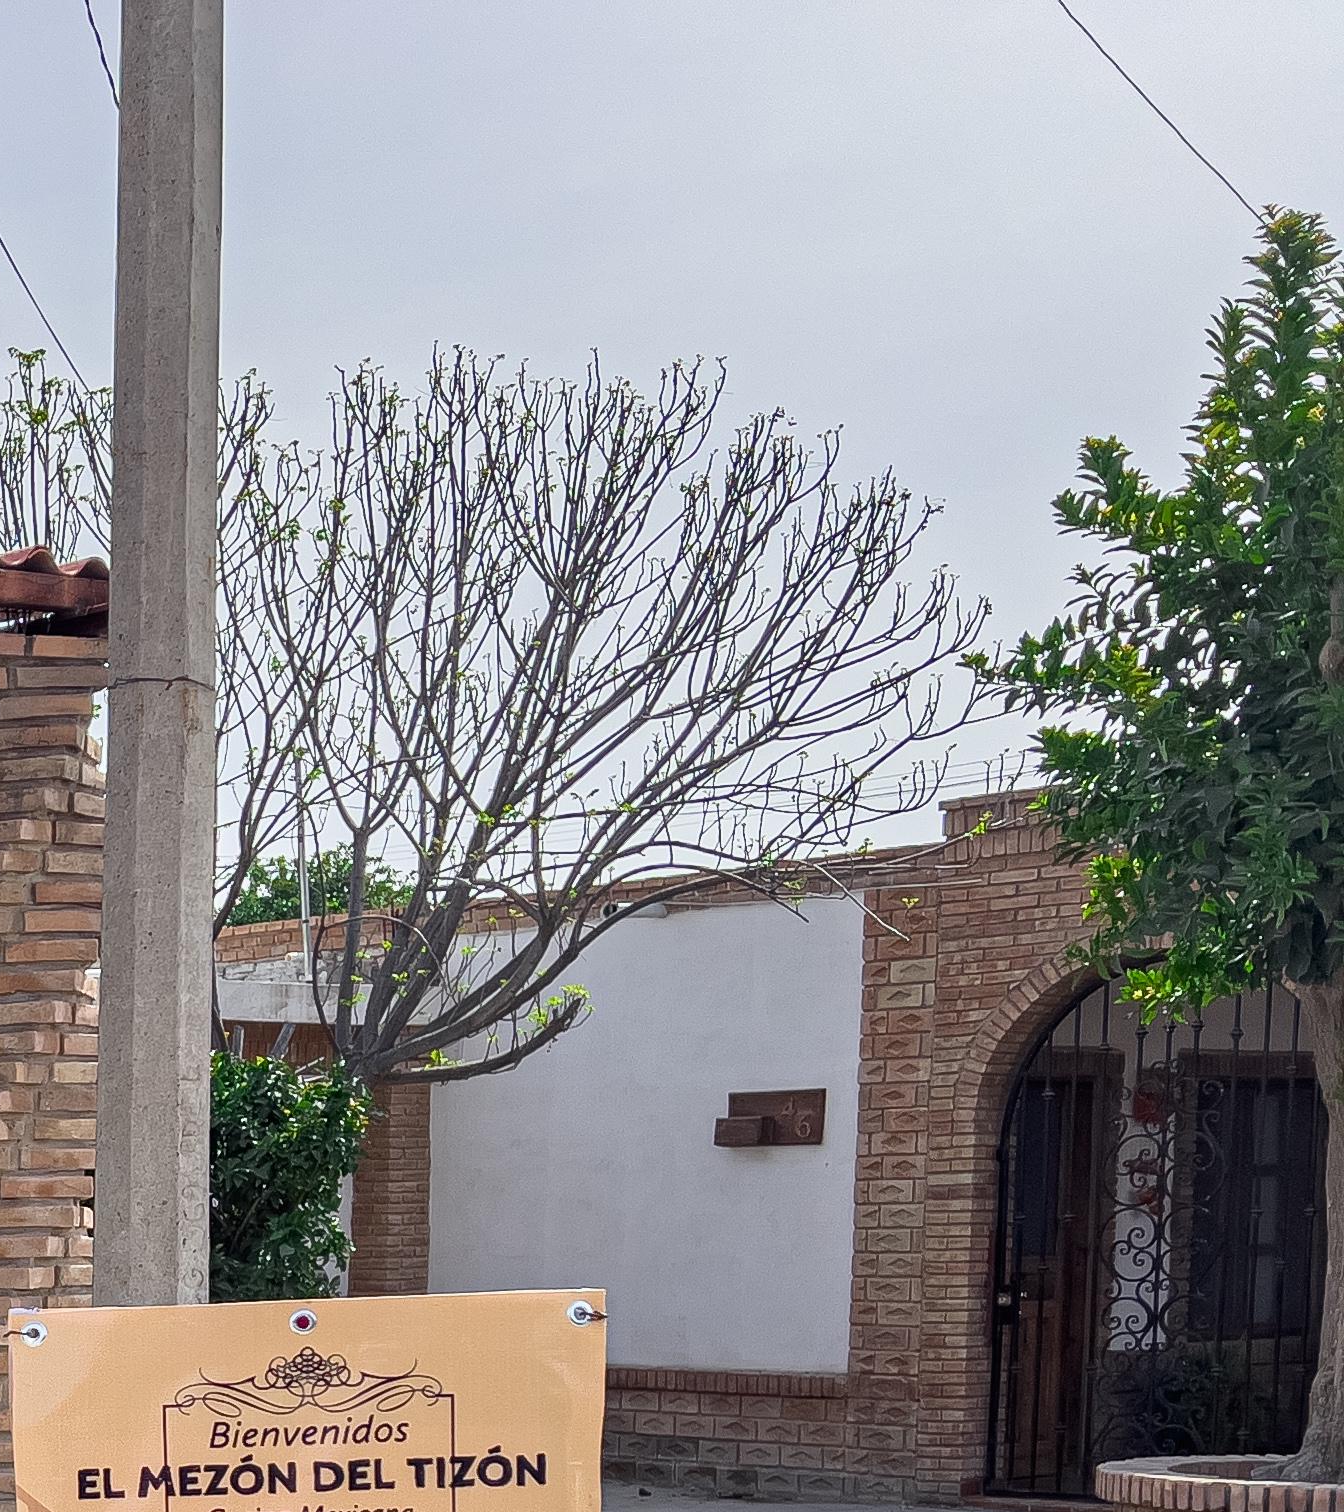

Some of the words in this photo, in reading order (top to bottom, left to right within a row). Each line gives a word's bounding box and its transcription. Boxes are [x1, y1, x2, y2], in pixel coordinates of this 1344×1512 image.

[209, 1414, 409, 1449] Bienvenidos
[77, 1467, 126, 1501] EL
[137, 1454, 297, 1497] MEZÓN
[312, 1458, 396, 1493] DEL
[407, 1445, 547, 1488] TIZÓN
